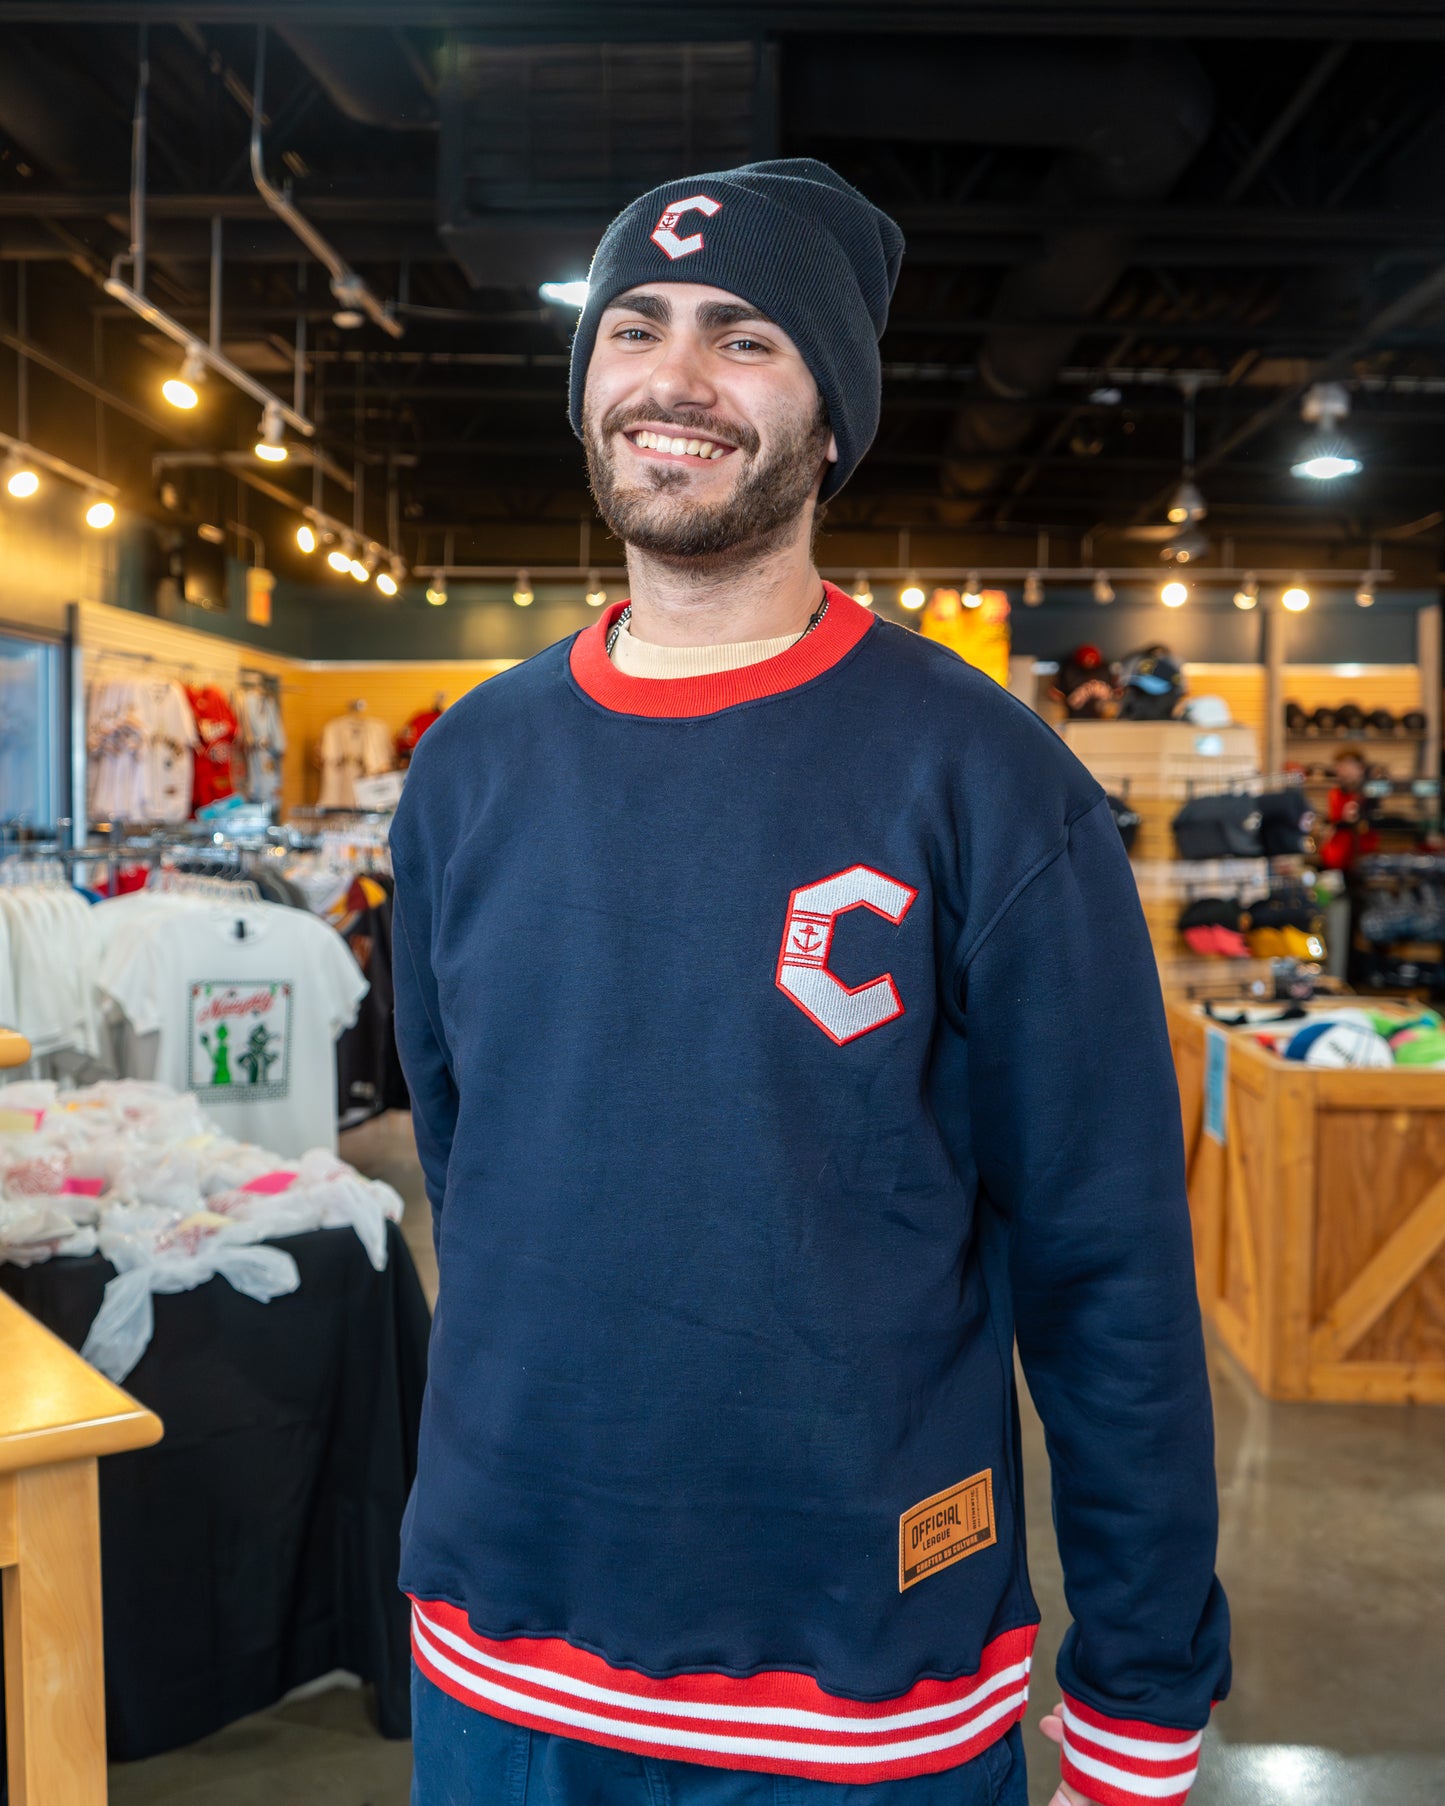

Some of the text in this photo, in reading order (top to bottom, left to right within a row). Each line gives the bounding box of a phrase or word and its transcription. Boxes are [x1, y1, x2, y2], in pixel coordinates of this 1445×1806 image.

[650, 194, 723, 260] C
[775, 863, 919, 1047] C
[911, 1503, 962, 1550] OFFICIAL
[922, 1528, 951, 1551] LEAGUE
[952, 1534, 978, 1554] CULTURE
